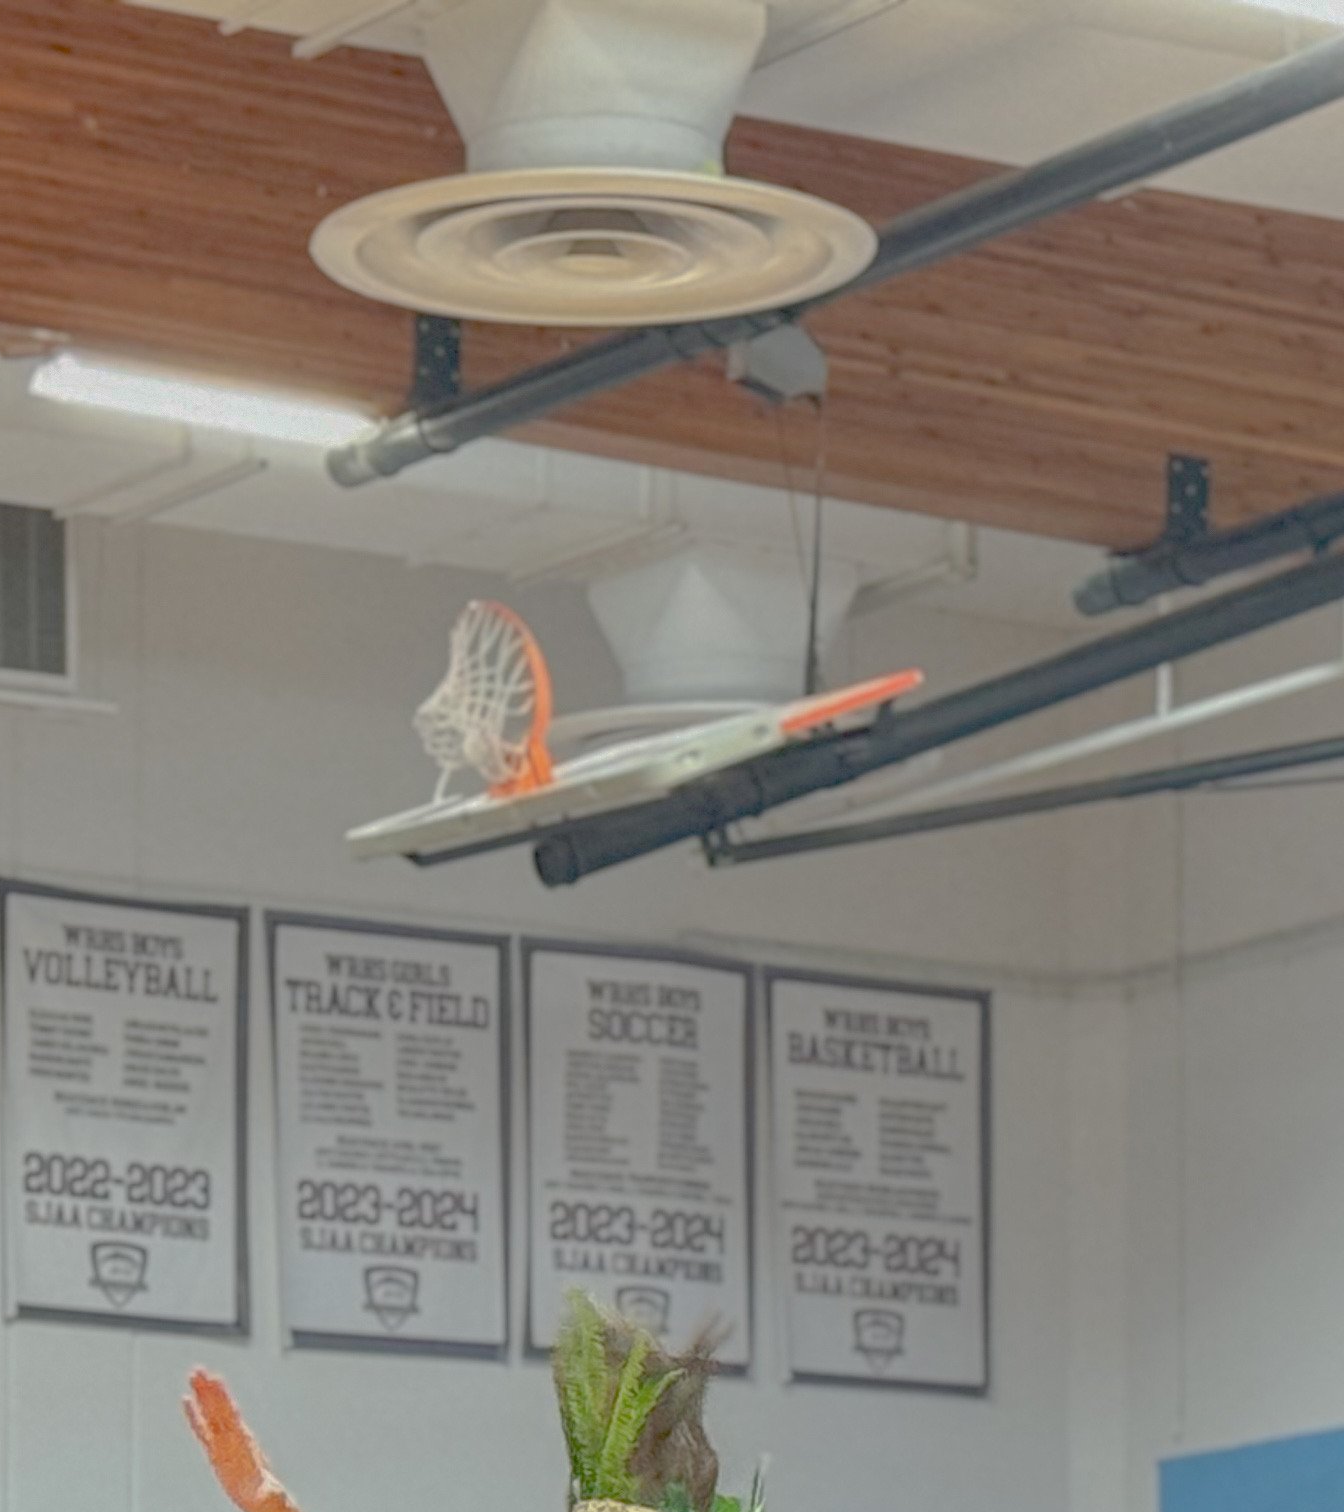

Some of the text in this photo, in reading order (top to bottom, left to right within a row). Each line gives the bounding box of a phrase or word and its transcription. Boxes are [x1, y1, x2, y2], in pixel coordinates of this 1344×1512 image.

[63, 925, 185, 961] WRHS BOYS
[24, 948, 218, 1003] VOLLEYBALL
[325, 953, 450, 987] WRHS GIRLS
[285, 978, 384, 1021] TRACK
[408, 992, 490, 1029] FIELD
[587, 1007, 697, 1050] SOCCER
[787, 1031, 964, 1082] BASKETBALL
[24, 1152, 210, 1211] 2022-2023
[87, 1206, 209, 1241] CHAMPIONS
[298, 1178, 480, 1234] 2023-2024
[551, 1200, 724, 1254] 2023-2024
[358, 1231, 477, 1263] CHAMPIONS
[611, 1252, 724, 1284] CHAMPIONS
[792, 1225, 961, 1278] 2023-2024
[850, 1273, 960, 1308] CHAMPIONS
